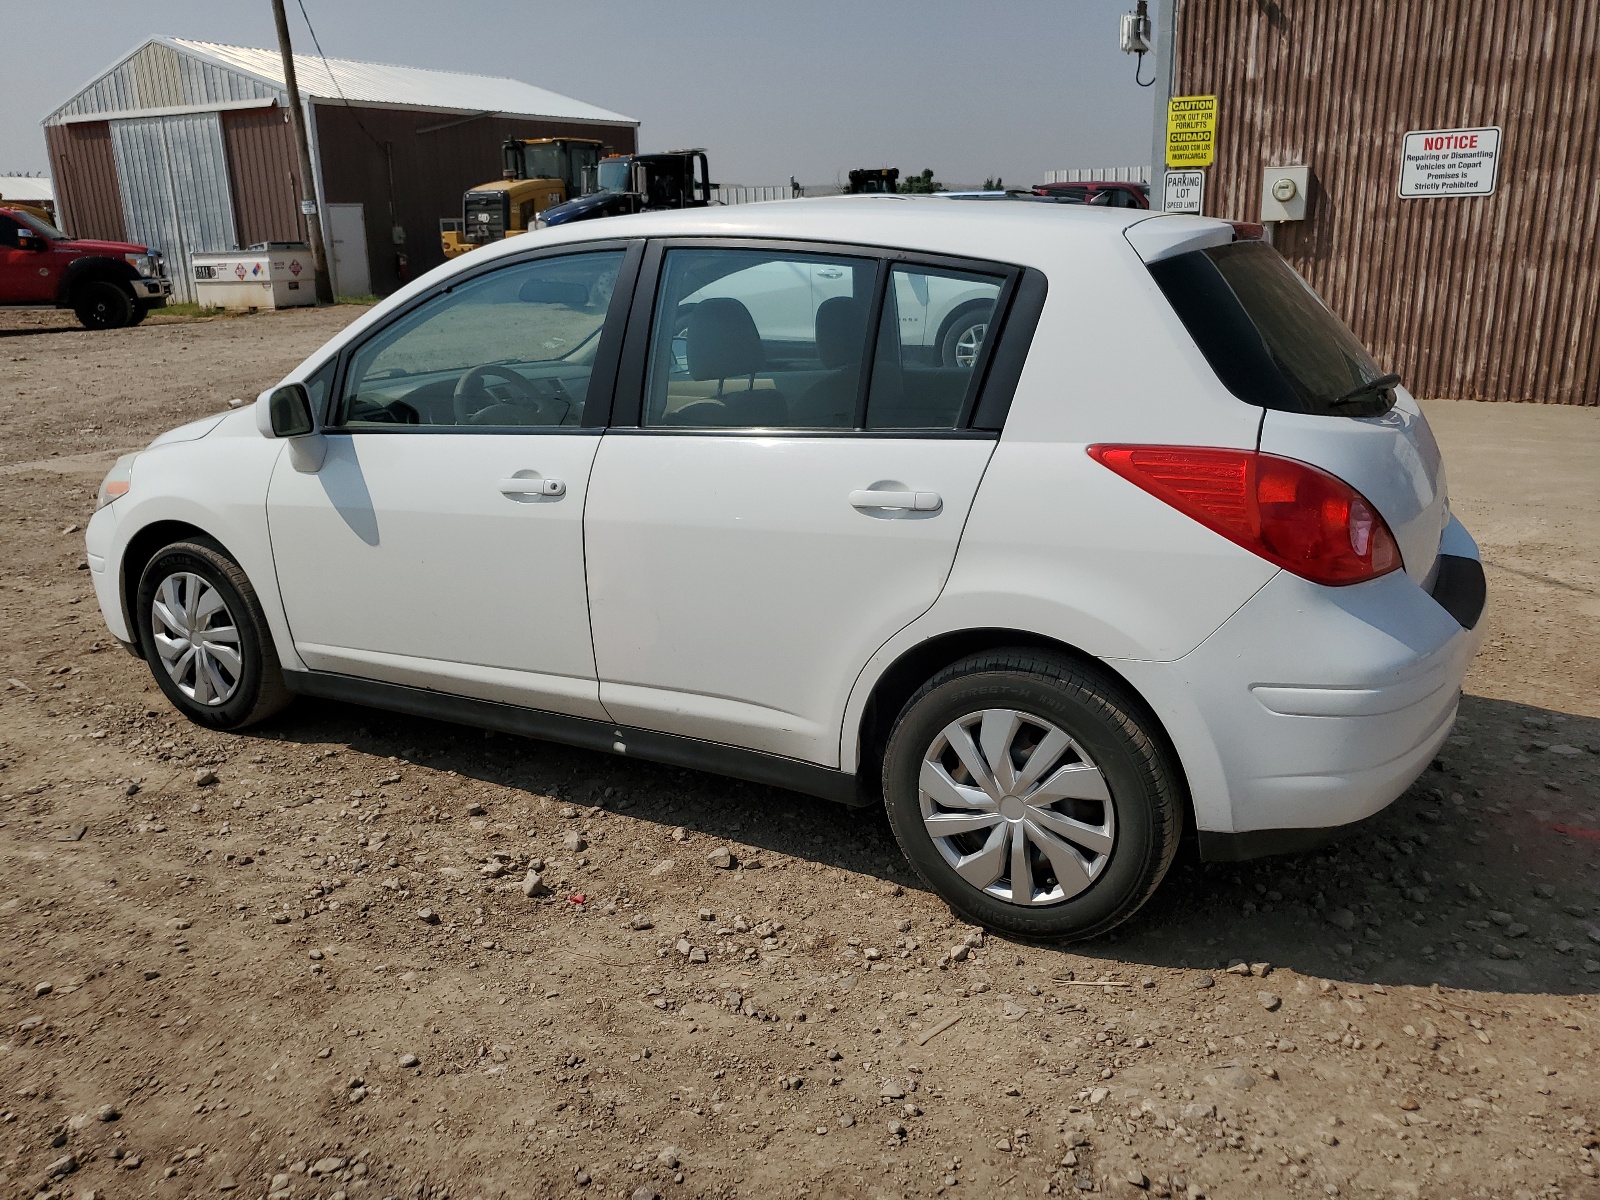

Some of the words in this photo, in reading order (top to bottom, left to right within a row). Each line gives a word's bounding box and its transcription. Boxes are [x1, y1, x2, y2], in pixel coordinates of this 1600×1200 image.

[1172, 101, 1213, 111] CAUTION
[1170, 113, 1186, 122] LOOK
[1187, 113, 1199, 121] OUT
[1200, 112, 1213, 120] FOR
[1175, 121, 1207, 130] FORKLIFTS
[1171, 132, 1211, 142] CUIDADO
[1169, 144, 1190, 152] CUIDADO
[1201, 143, 1211, 151] LOS
[1423, 135, 1479, 151] NOTICE
[1171, 152, 1207, 160] MONTACARGAS
[1406, 153, 1440, 162] Repairing
[1450, 150, 1494, 160] Dismantling
[1415, 162, 1446, 171] Vehicles
[1457, 161, 1482, 170] Copart
[1426, 172, 1460, 180] Premises
[1167, 176, 1200, 187] PARKING
[1414, 182, 1440, 191] Strictly
[1441, 181, 1479, 190] Prohibited
[1176, 188, 1190, 199] LOT
